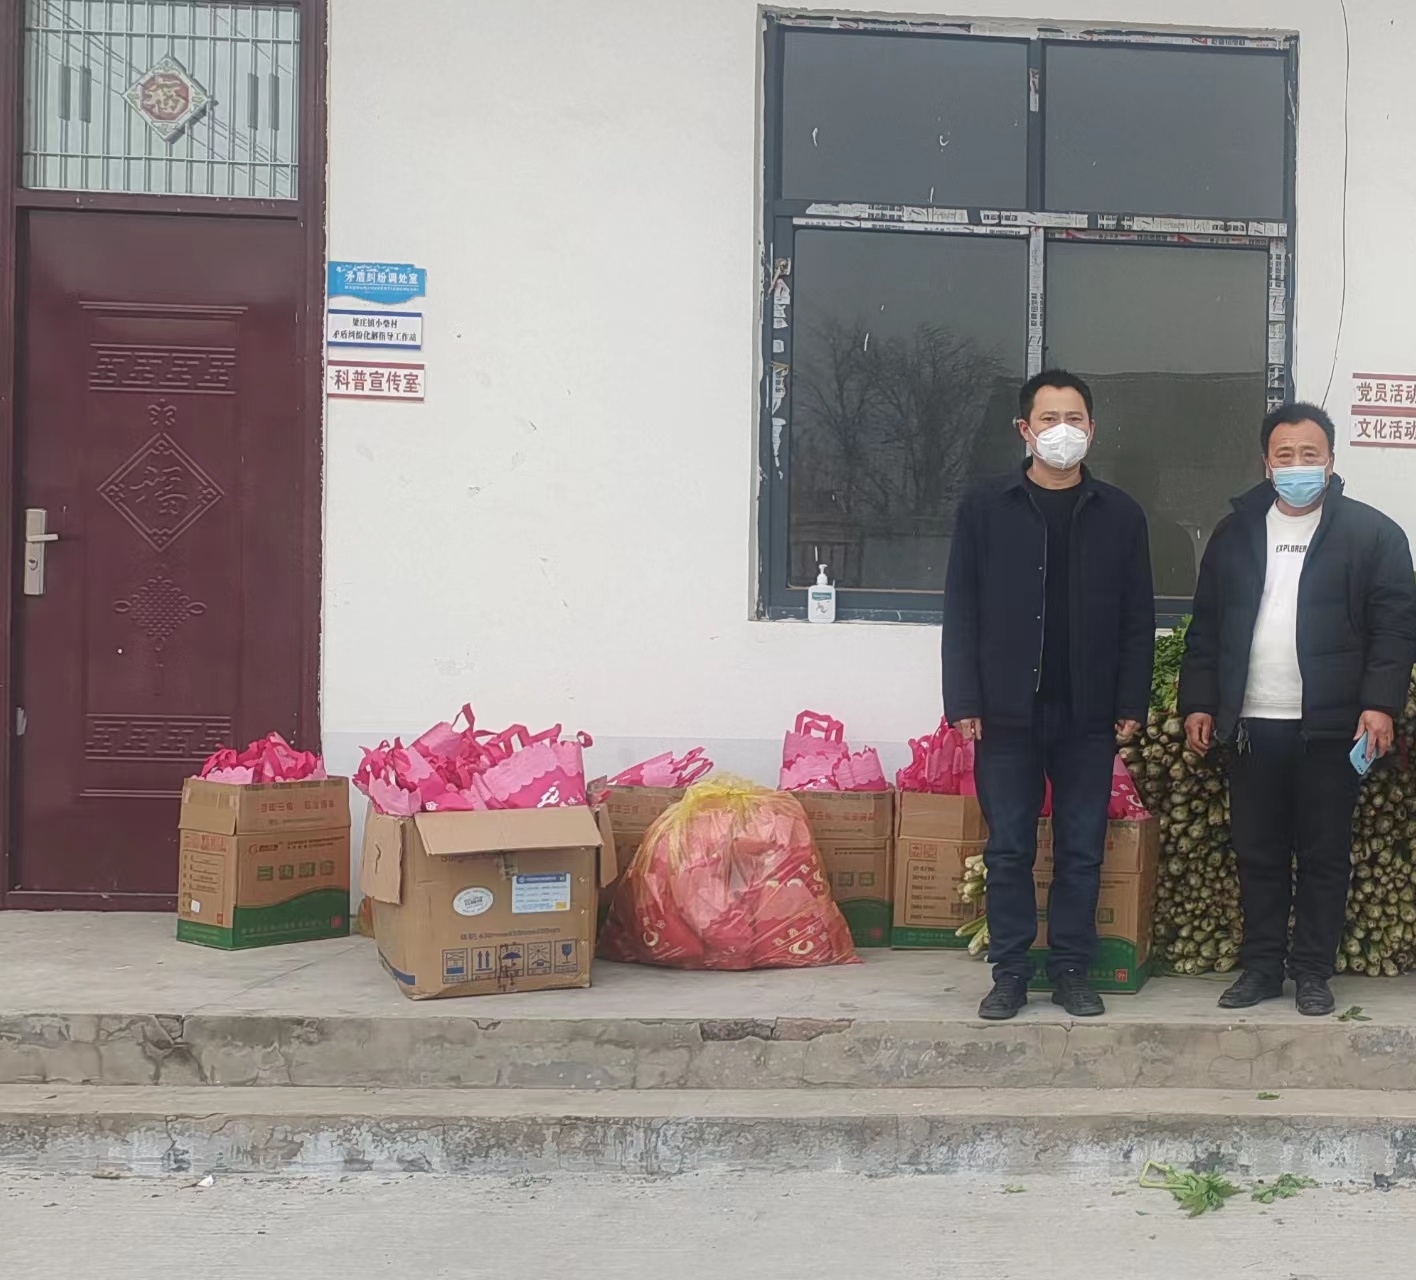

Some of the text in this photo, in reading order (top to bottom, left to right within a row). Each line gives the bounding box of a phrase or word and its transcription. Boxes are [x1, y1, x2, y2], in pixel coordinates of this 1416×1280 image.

[344, 270, 419, 285] 矛盾纠纷调处室
[334, 369, 419, 393] 科普宣传室
